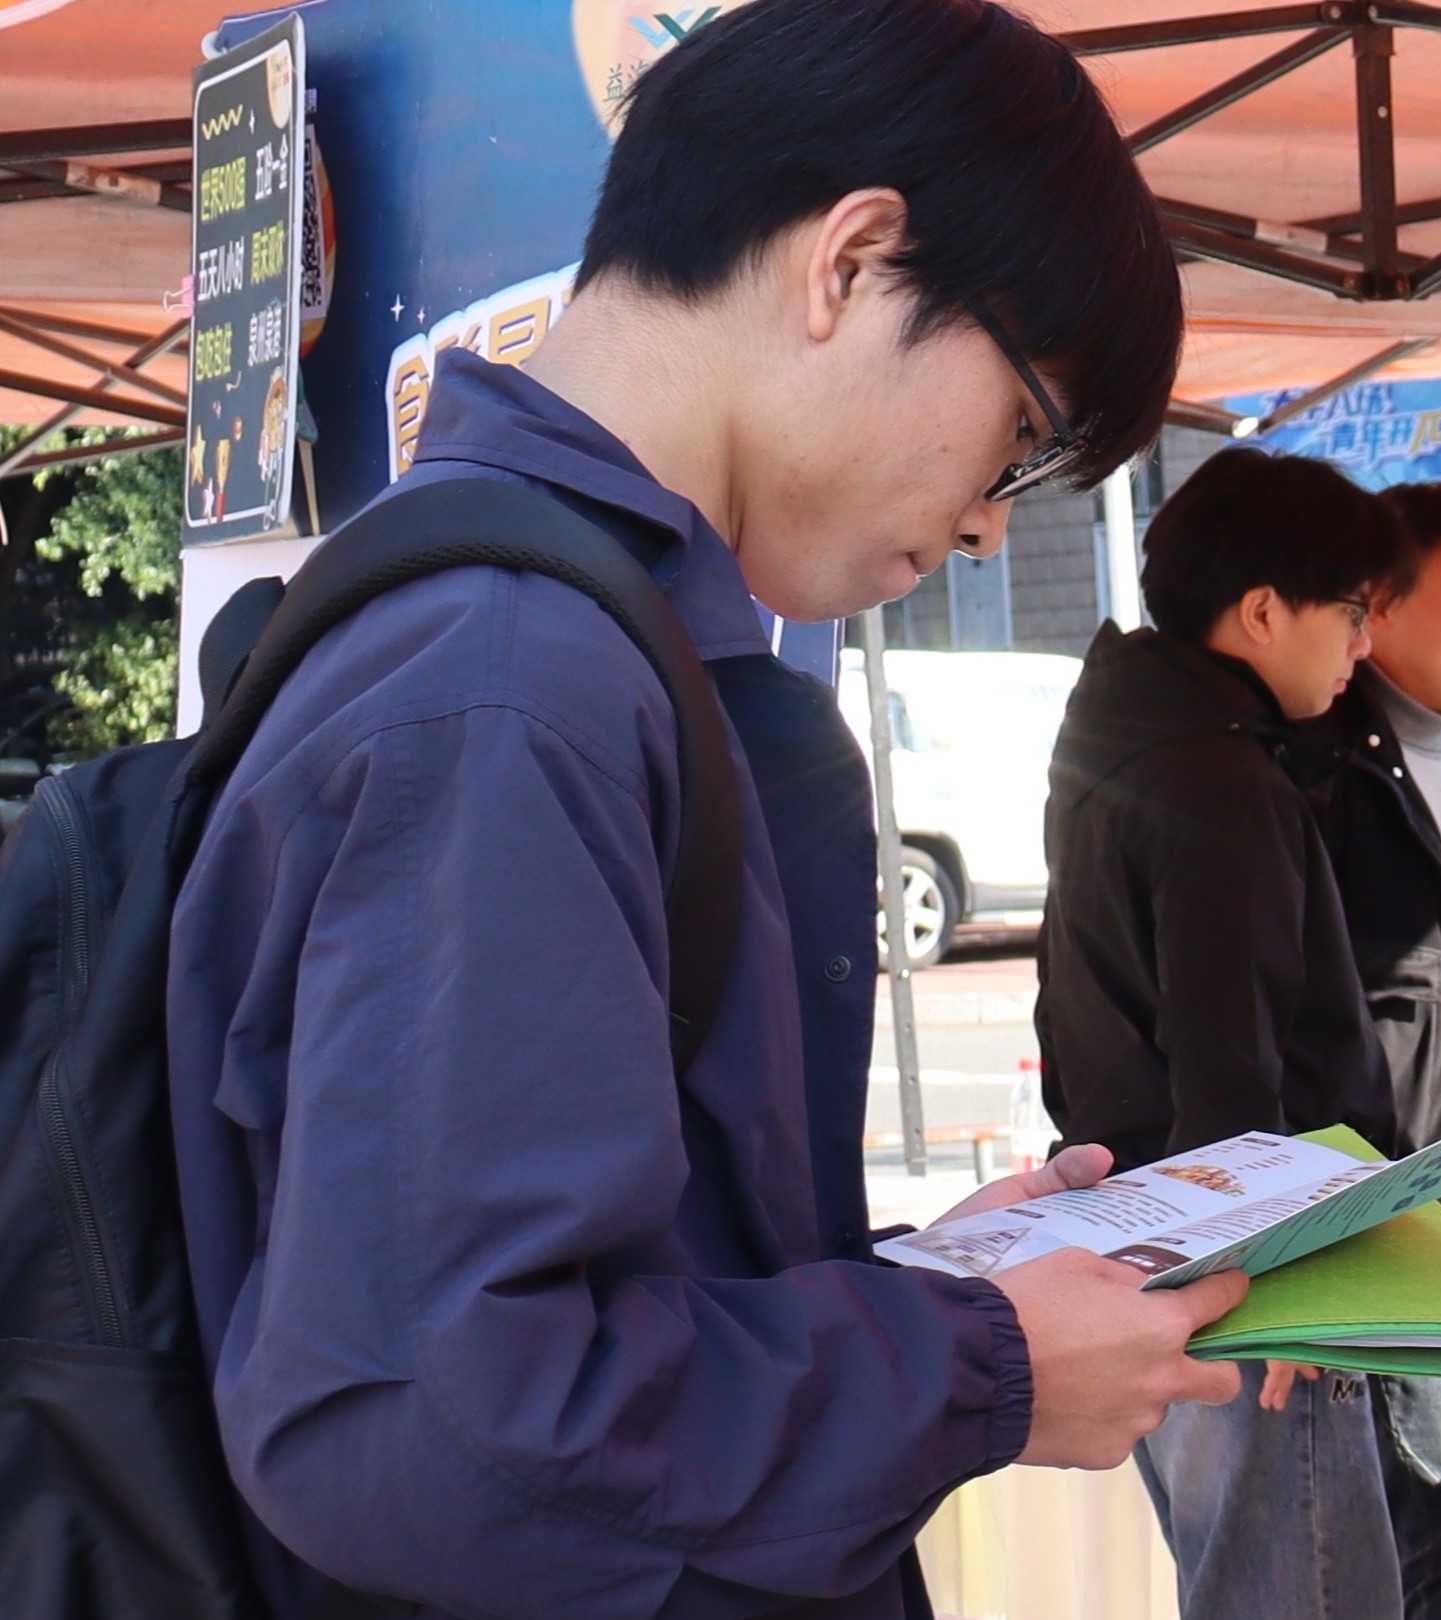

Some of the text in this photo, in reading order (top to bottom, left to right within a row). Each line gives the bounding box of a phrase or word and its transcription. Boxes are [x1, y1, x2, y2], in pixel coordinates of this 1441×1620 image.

[201, 156, 246, 221] 世界500强
[254, 134, 288, 200] 五险一金
[198, 235, 245, 301] 五天八小时
